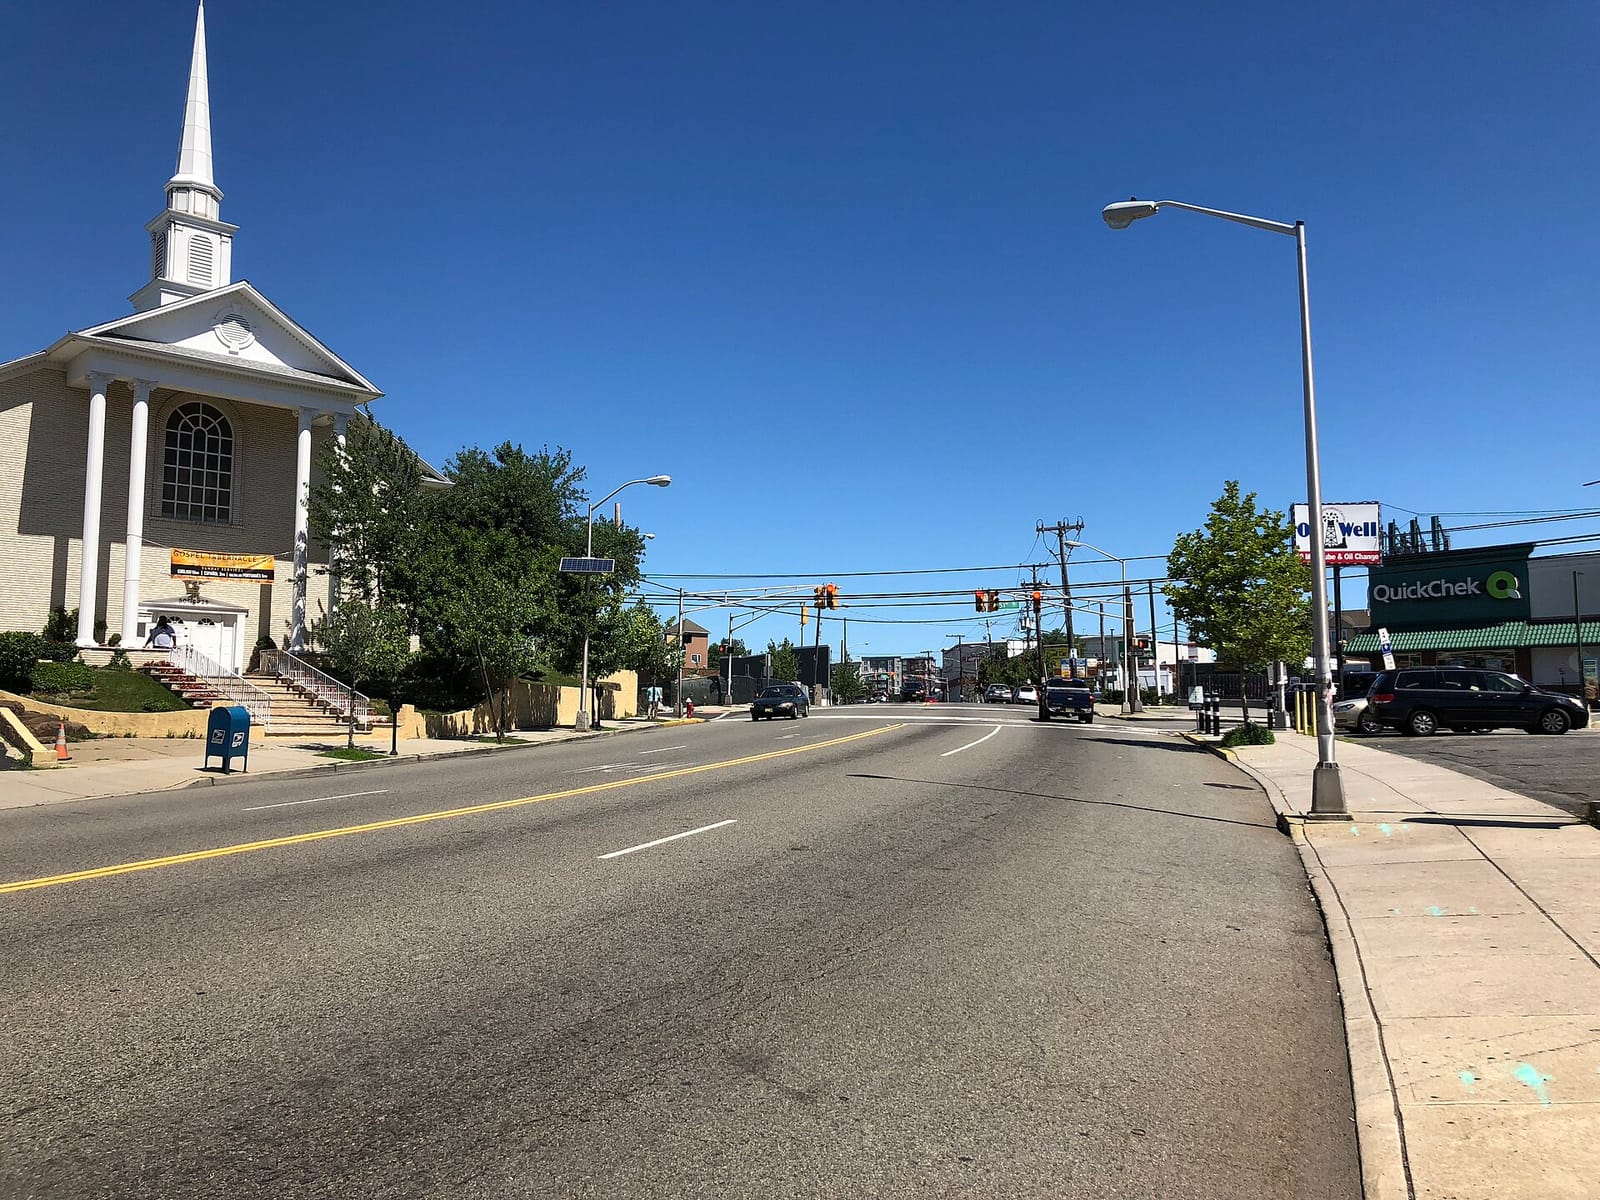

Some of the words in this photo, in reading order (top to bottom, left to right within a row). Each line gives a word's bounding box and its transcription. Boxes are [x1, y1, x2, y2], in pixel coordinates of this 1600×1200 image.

[1338, 521, 1377, 537] Well
[173, 549, 204, 559] GOSPEL
[208, 553, 257, 563] TABERNACLE
[1344, 552, 1354, 560] Oil
[1354, 553, 1379, 562] Change
[1373, 577, 1481, 603] QuickChek
